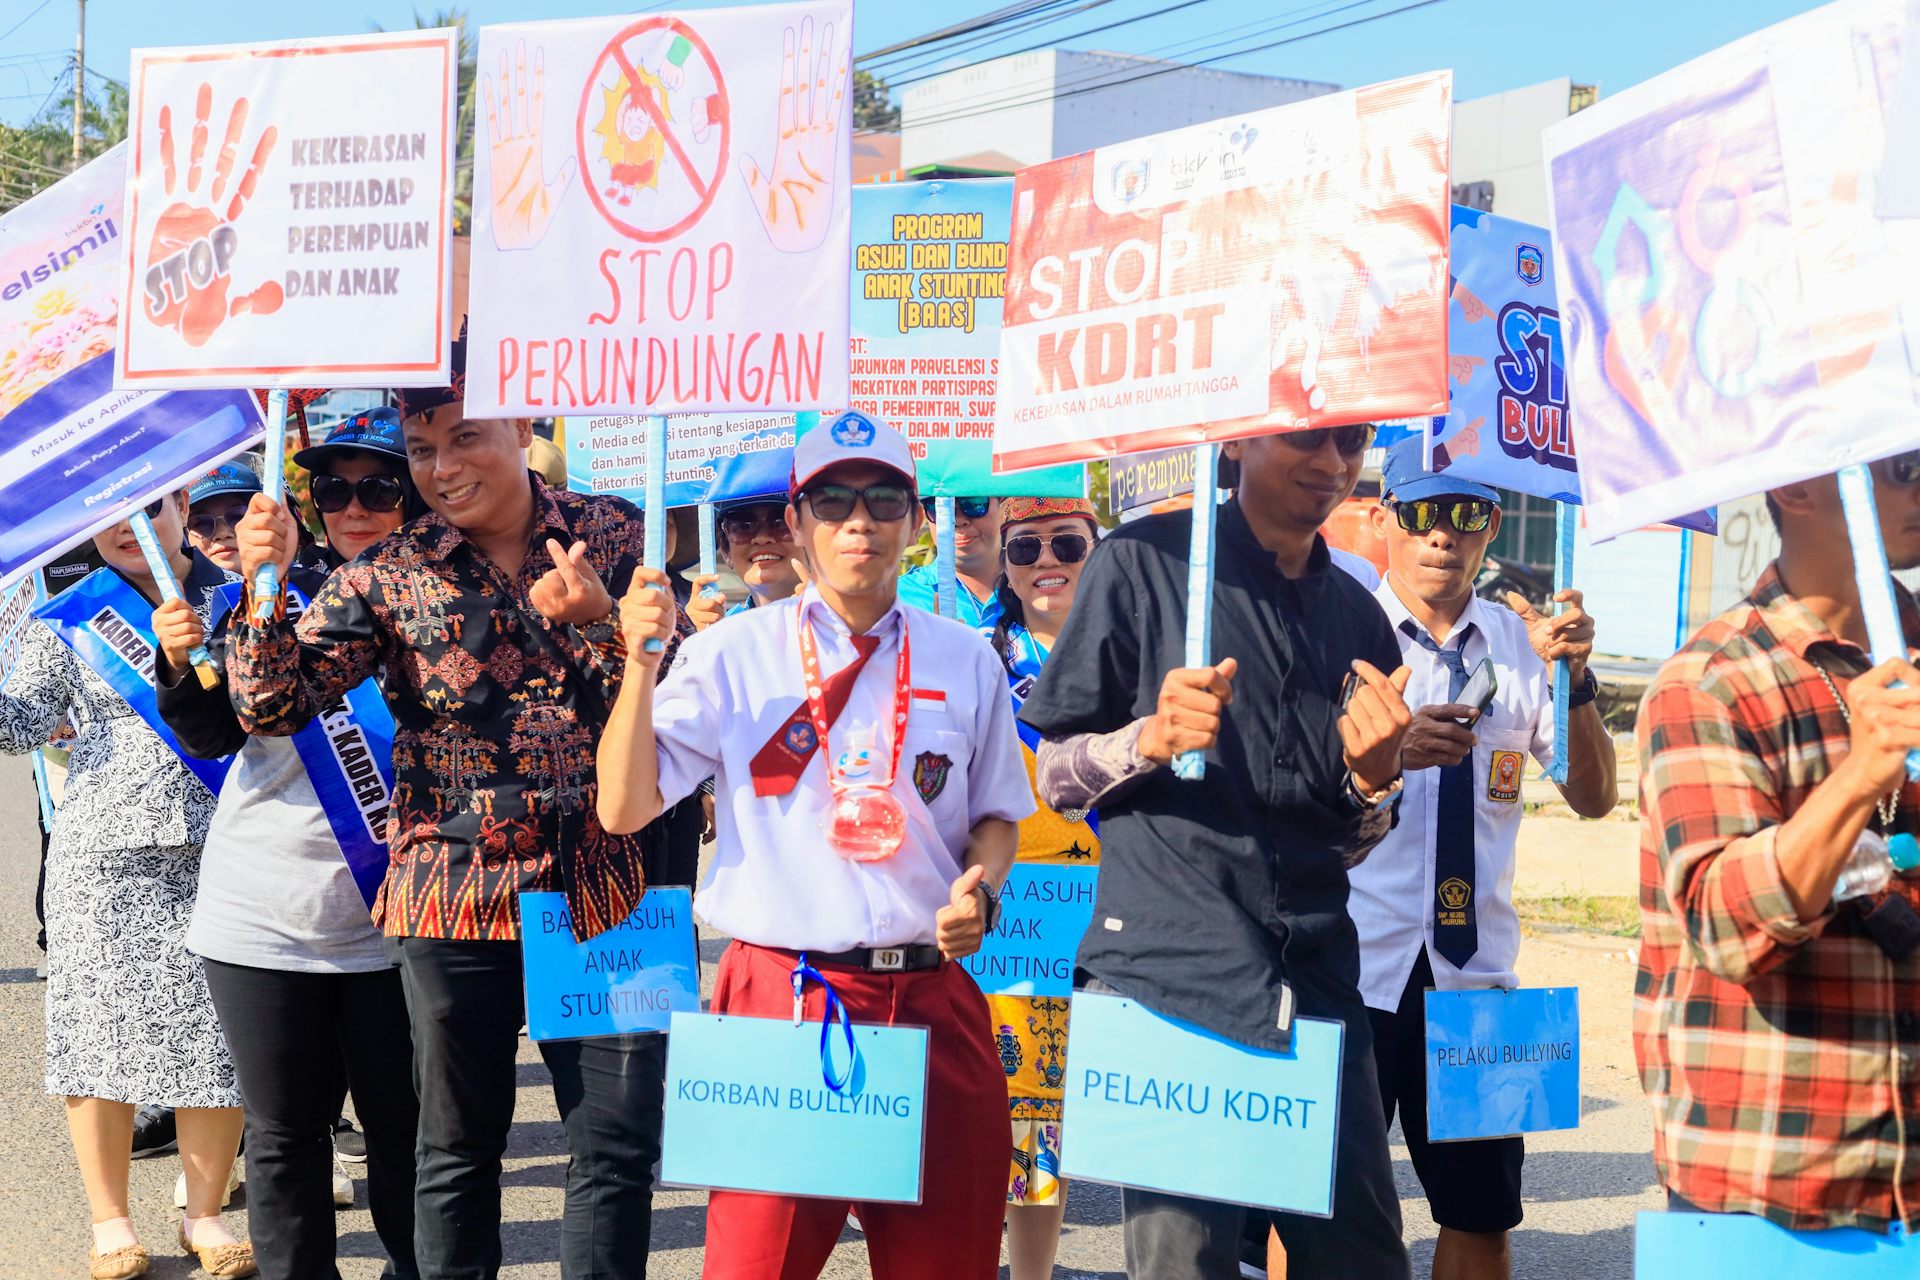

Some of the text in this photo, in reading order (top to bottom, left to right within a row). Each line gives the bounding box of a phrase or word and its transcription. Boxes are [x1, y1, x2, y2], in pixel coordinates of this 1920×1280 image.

[291, 133, 426, 167] KEKERASAN
[289, 177, 415, 210] TERHADAP
[287, 221, 429, 254] PEREMPUAN
[893, 212, 983, 241] PROGRAM
[2, 218, 118, 301] elsimil
[145, 226, 238, 312] STOP
[856, 242, 1009, 271] ASUH DAN BUND
[285, 267, 400, 298] DAN ANAK
[588, 241, 734, 325] STOP
[864, 273, 914, 299] ANAK
[1028, 232, 1198, 320] STOP
[1034, 303, 1225, 396] KDRT
[498, 331, 824, 408] PERUNDUNGAN
[911, 359, 985, 375] PRAVELENSI
[882, 401, 963, 418] PEMERINTAH,
[1013, 375, 1239, 424] KEKERASAN DALAM RUMAH TANGGA
[31, 430, 75, 457] Masuk
[78, 416, 94, 430] ke
[590, 415, 634, 432] petugas
[592, 435, 628, 450] Media
[678, 425, 723, 438] tentang
[726, 417, 776, 433] kesiapan
[908, 421, 950, 438] DALAM
[64, 426, 146, 477] Belum Punya Akun?
[592, 457, 613, 470] dan
[617, 452, 648, 467] hami
[668, 448, 705, 460] utama
[709, 443, 735, 459] yang
[739, 436, 777, 452] terkait
[83, 462, 153, 508] Registrasi
[593, 477, 627, 491] faktor
[665, 466, 716, 482] stunting.
[92, 609, 152, 668] KADER
[333, 728, 385, 809] KADER
[1023, 880, 1093, 903] ASUH
[984, 917, 1043, 940] NAK
[584, 948, 644, 974] ANAK
[959, 954, 1070, 980] UNTING
[561, 988, 670, 1018] STUNTING
[1437, 1042, 1571, 1067] PELAKU BULLYING
[677, 1078, 911, 1118] KORBAN BULLYING
[1084, 1069, 1317, 1130] PELAKU KDRT
